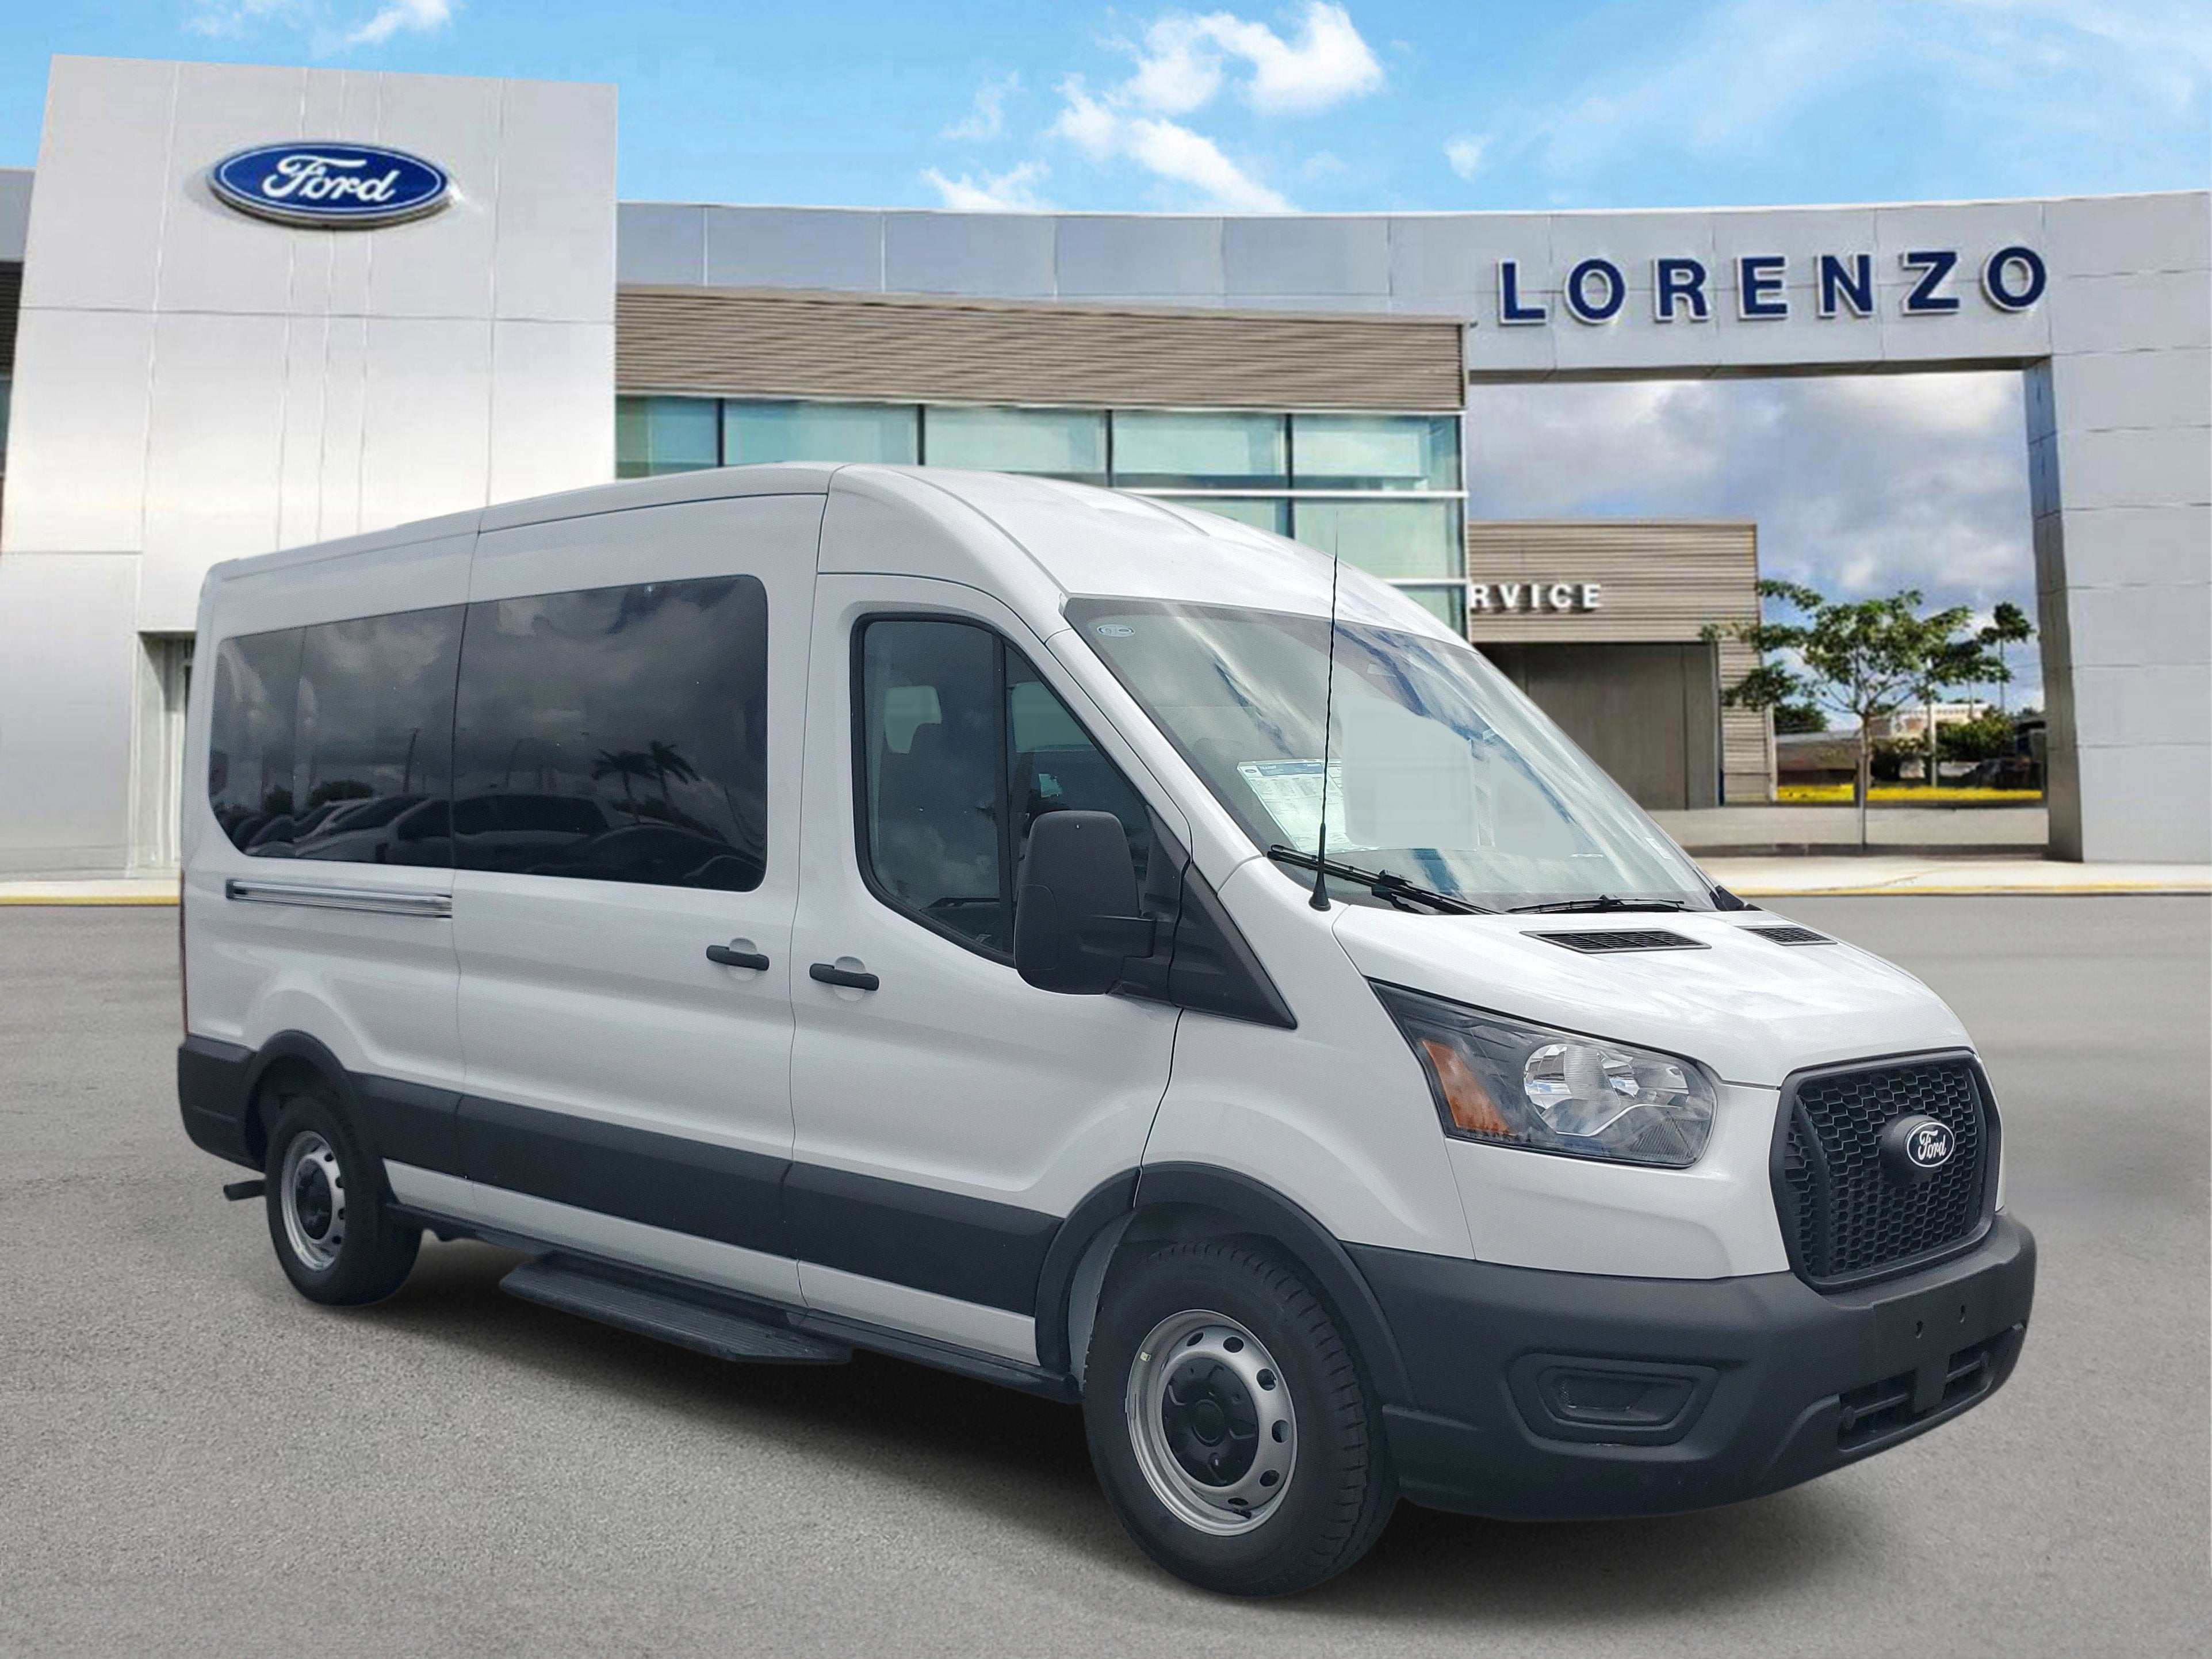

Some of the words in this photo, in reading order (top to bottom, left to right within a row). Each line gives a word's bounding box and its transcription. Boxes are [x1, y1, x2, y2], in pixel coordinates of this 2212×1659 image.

[262, 155, 400, 201] Ford
[1498, 246, 2048, 325] LORENZO
[1470, 583, 1601, 609] RVICE
[1918, 1129, 1947, 1161] Ford
